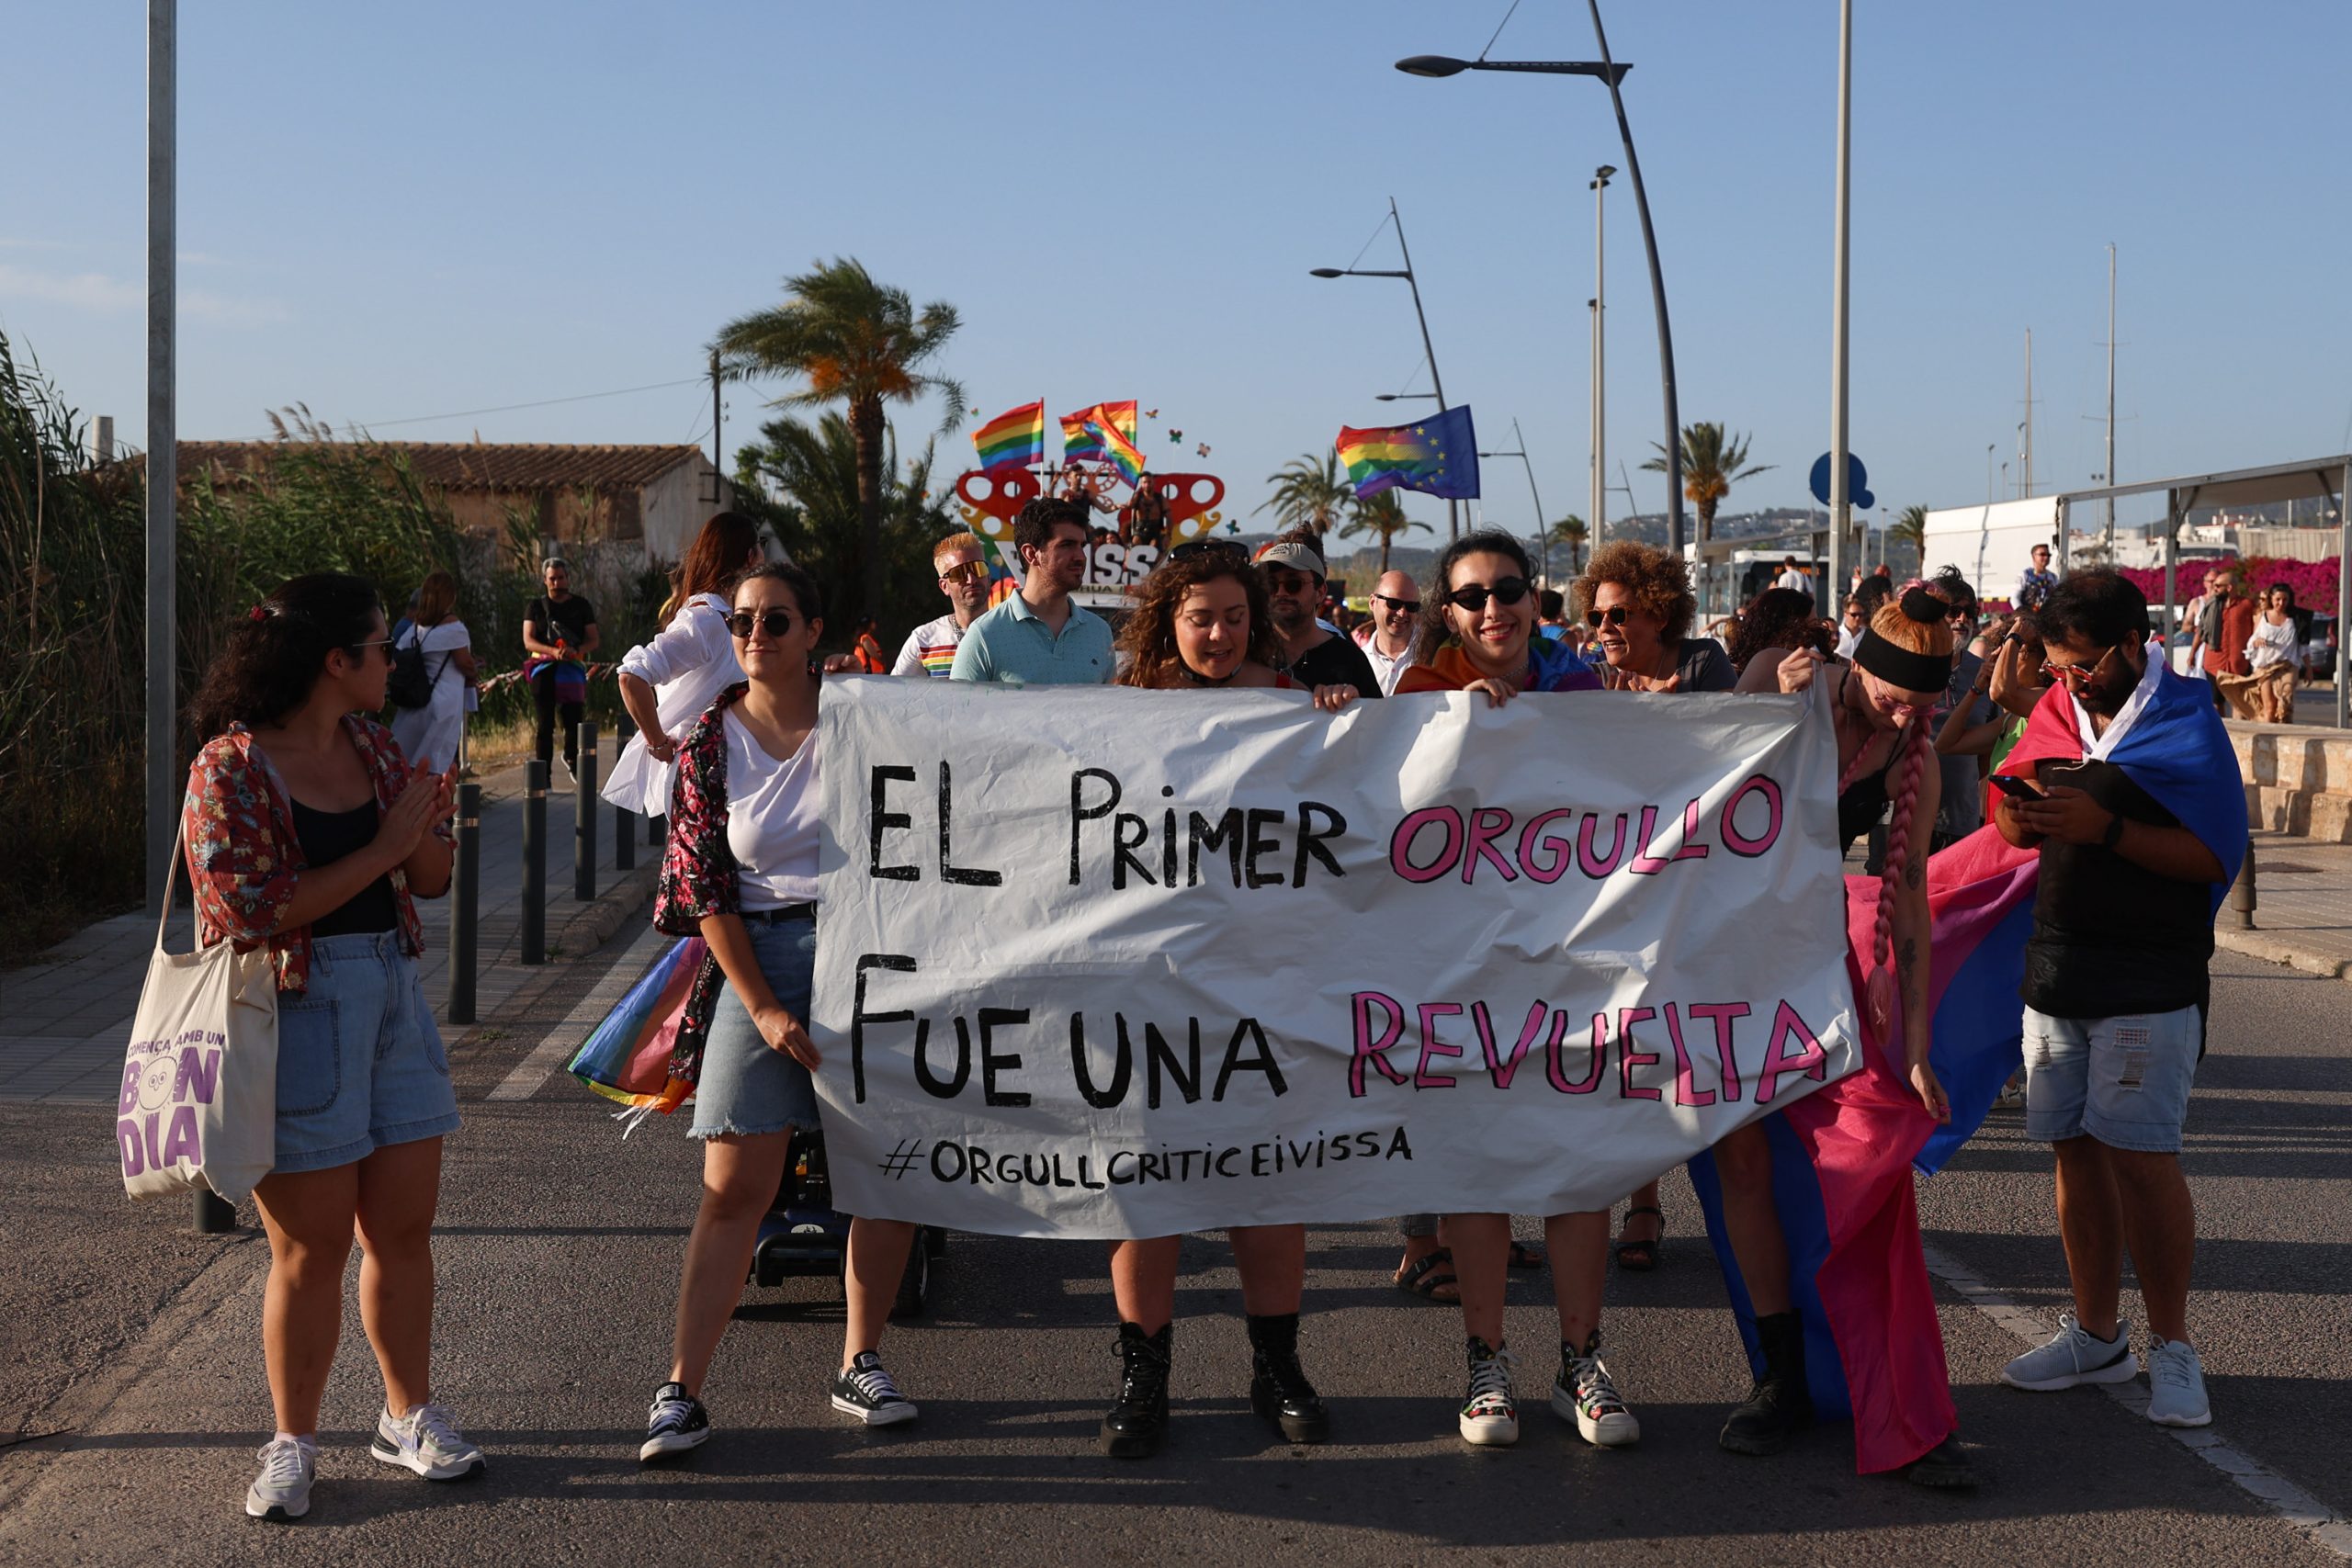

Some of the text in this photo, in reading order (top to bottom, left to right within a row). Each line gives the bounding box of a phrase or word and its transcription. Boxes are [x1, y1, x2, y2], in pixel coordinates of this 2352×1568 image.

[870, 760, 1002, 886] EL
[1390, 773, 1782, 884] ORGULLO
[175, 1030, 203, 1048] AMB
[207, 1031, 225, 1046] UN
[851, 953, 1828, 1110] FUE UNA REVUELTA
[117, 1106, 202, 1178] DIA
